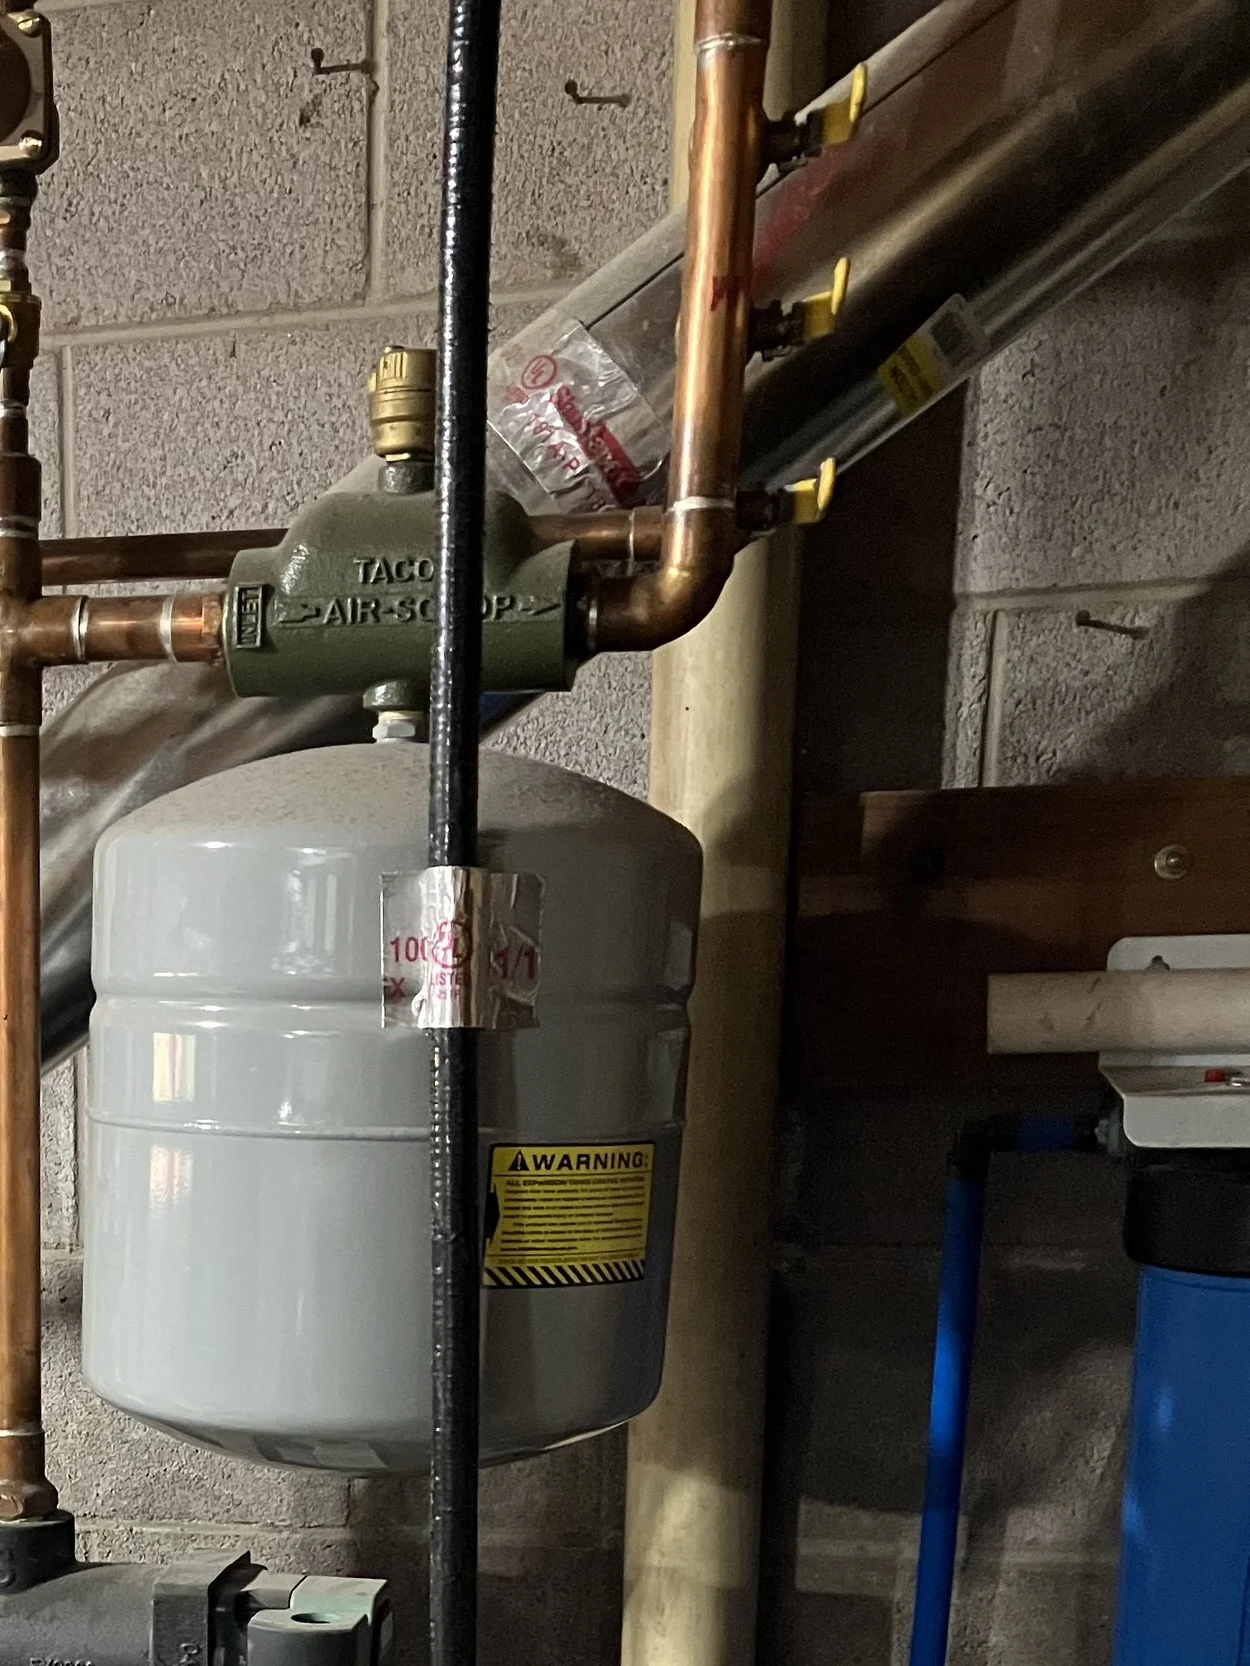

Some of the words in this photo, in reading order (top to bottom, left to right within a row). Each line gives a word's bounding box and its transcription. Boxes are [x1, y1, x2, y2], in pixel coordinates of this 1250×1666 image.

[353, 556, 435, 584] TACO
[241, 590, 258, 644] INLET
[532, 1151, 648, 1171] WARNING:
